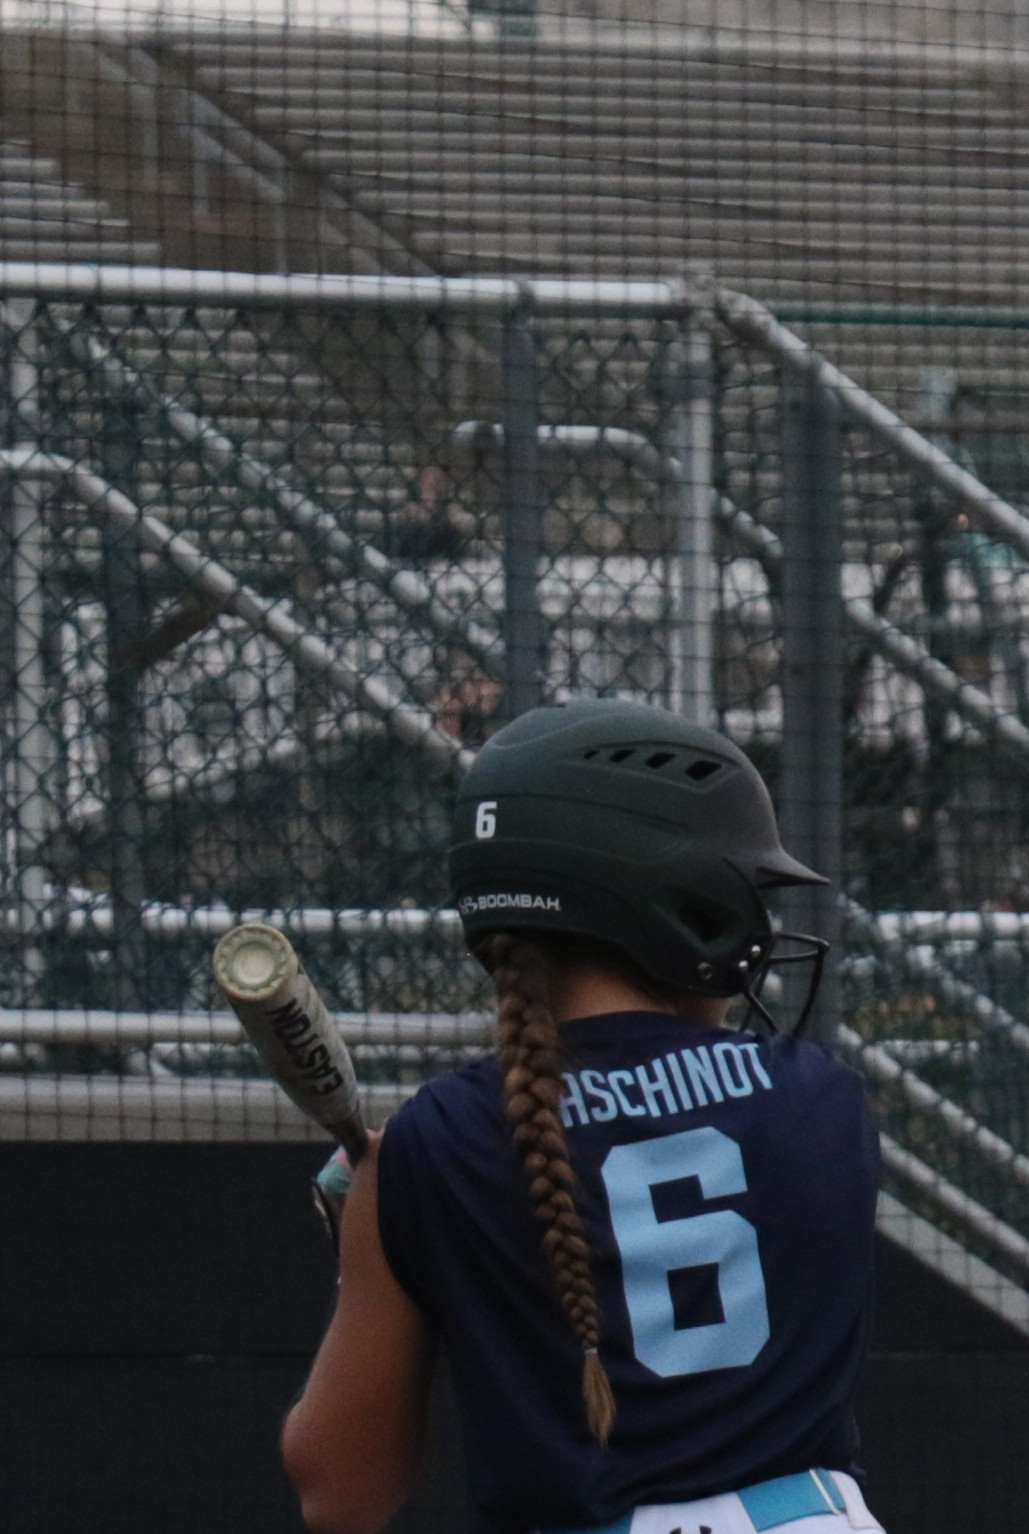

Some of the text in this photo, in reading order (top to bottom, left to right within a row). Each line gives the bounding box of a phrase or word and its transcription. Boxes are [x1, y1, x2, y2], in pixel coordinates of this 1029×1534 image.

[475, 801, 497, 839] 6
[477, 893, 561, 912] BOOMBAH
[600, 1126, 771, 1378] 6
